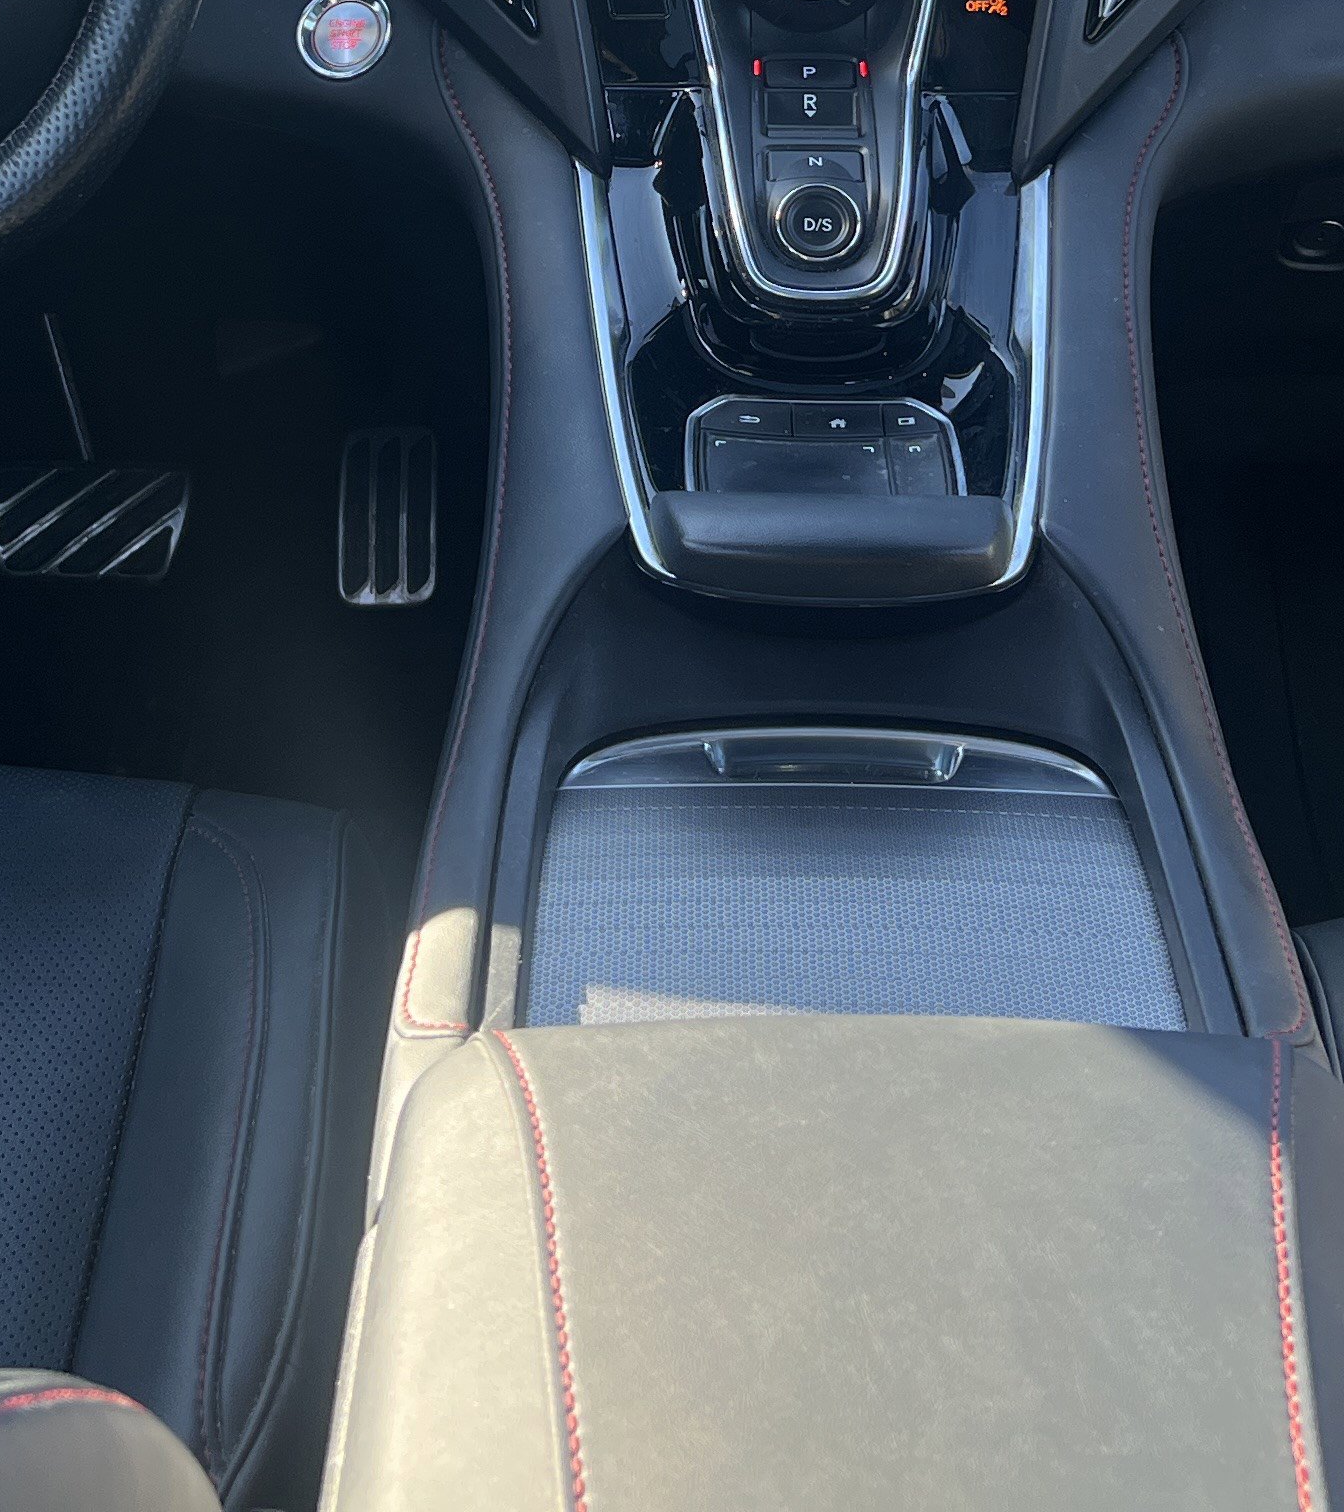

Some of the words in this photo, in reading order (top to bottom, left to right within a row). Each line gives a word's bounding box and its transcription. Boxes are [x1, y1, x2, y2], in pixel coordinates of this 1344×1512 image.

[965, 0, 990, 12] OFF
[328, 18, 367, 29] ENGINE
[329, 28, 363, 38] START
[331, 40, 358, 50] STOP
[802, 66, 816, 79] P
[804, 94, 817, 110] R
[808, 157, 823, 166] N
[803, 217, 833, 233] D/S
